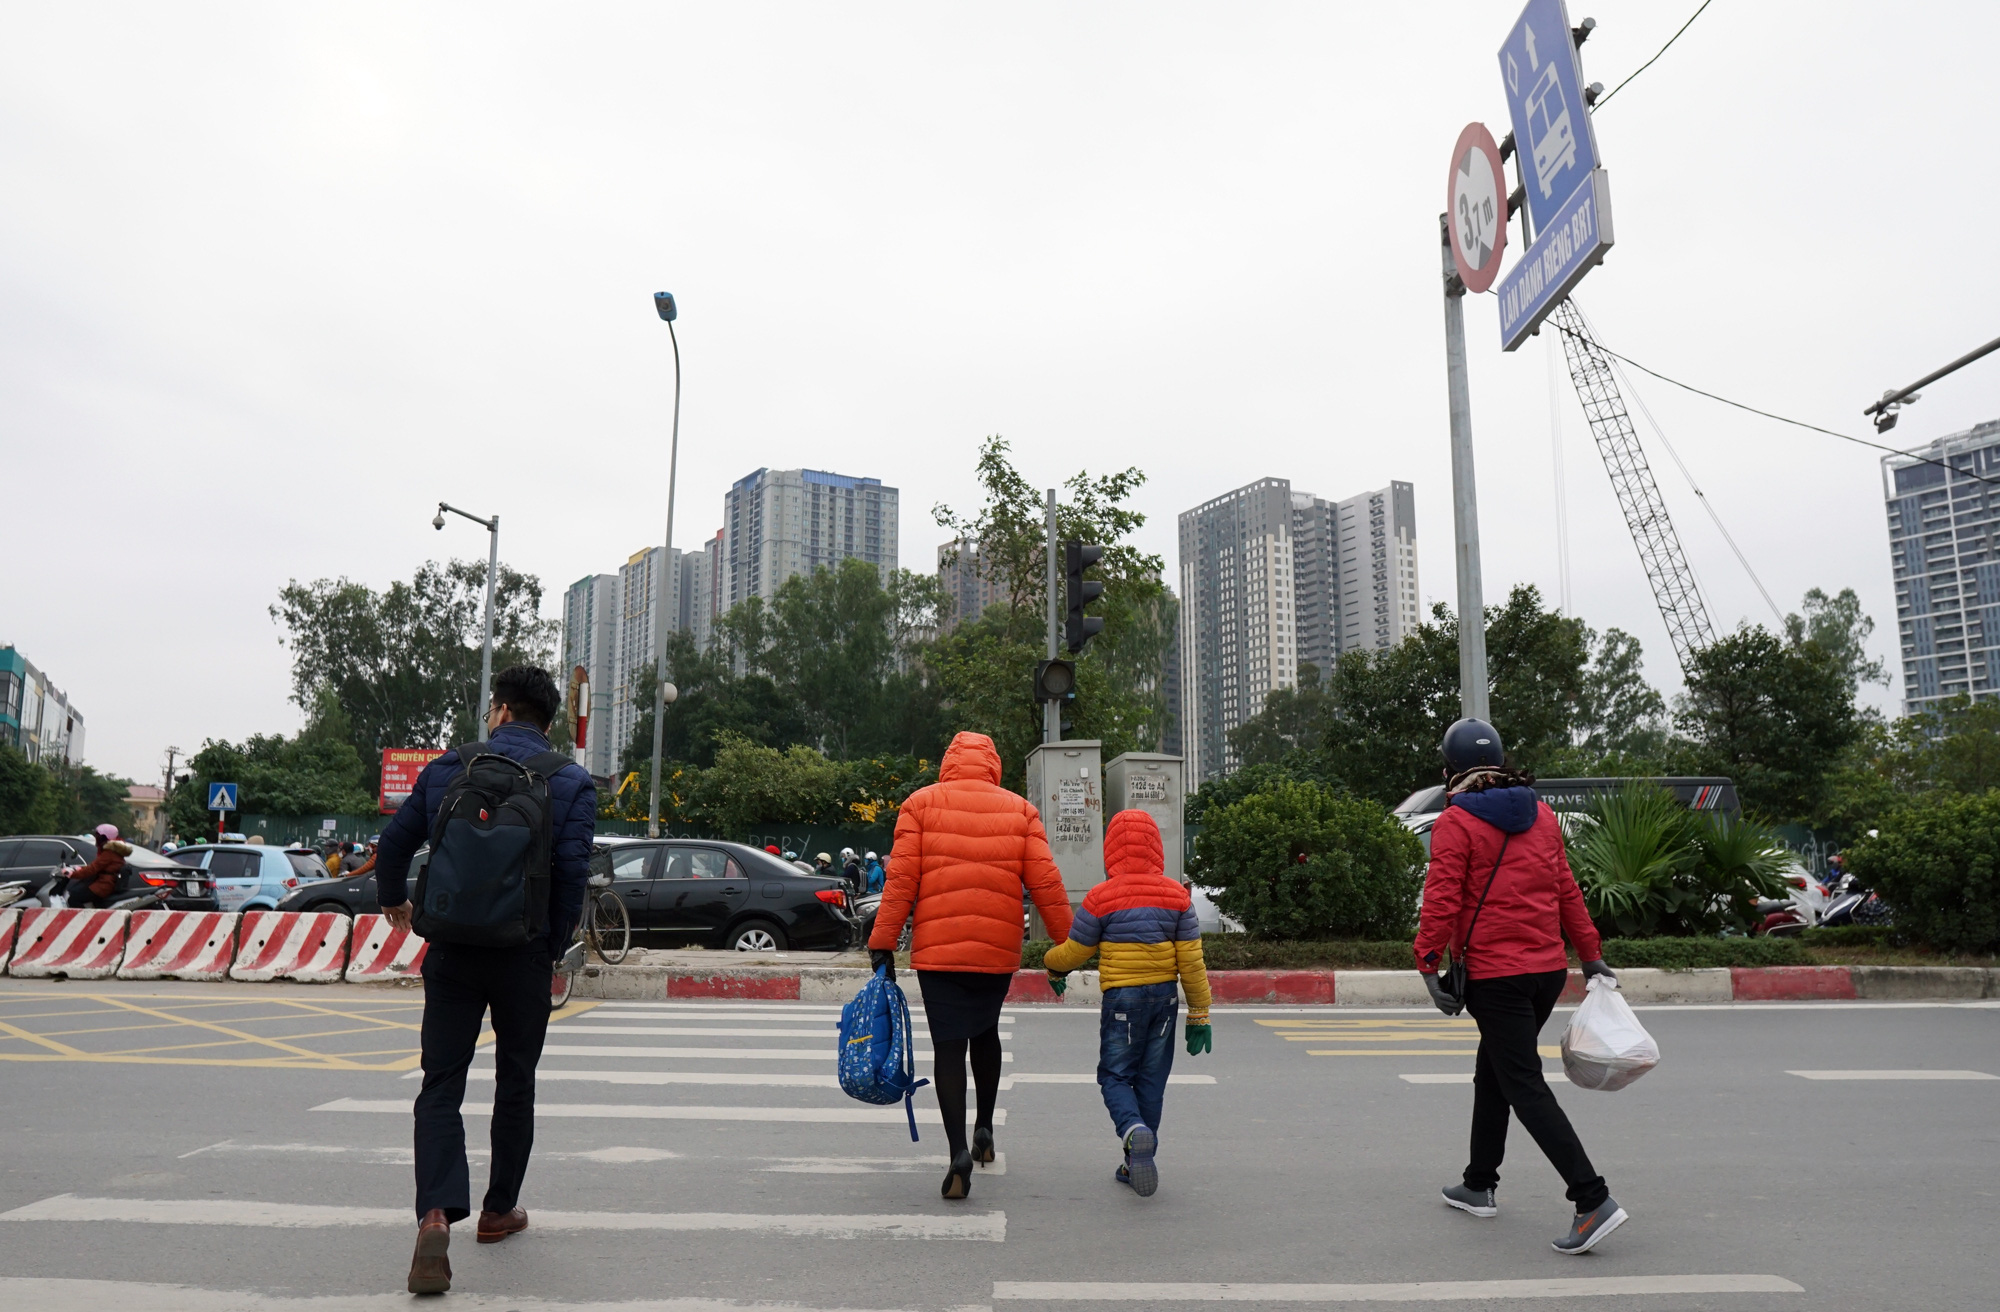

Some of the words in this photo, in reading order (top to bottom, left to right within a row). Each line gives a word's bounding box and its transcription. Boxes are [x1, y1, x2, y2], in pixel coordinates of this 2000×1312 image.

[1482, 195, 1494, 226] m
[1502, 285, 1520, 332] LÀN
[1518, 264, 1544, 313] DÀNH
[1542, 232, 1573, 286] RIÊNG
[1571, 197, 1593, 253] BRT
[391, 752, 424, 762] CHUYÊN
